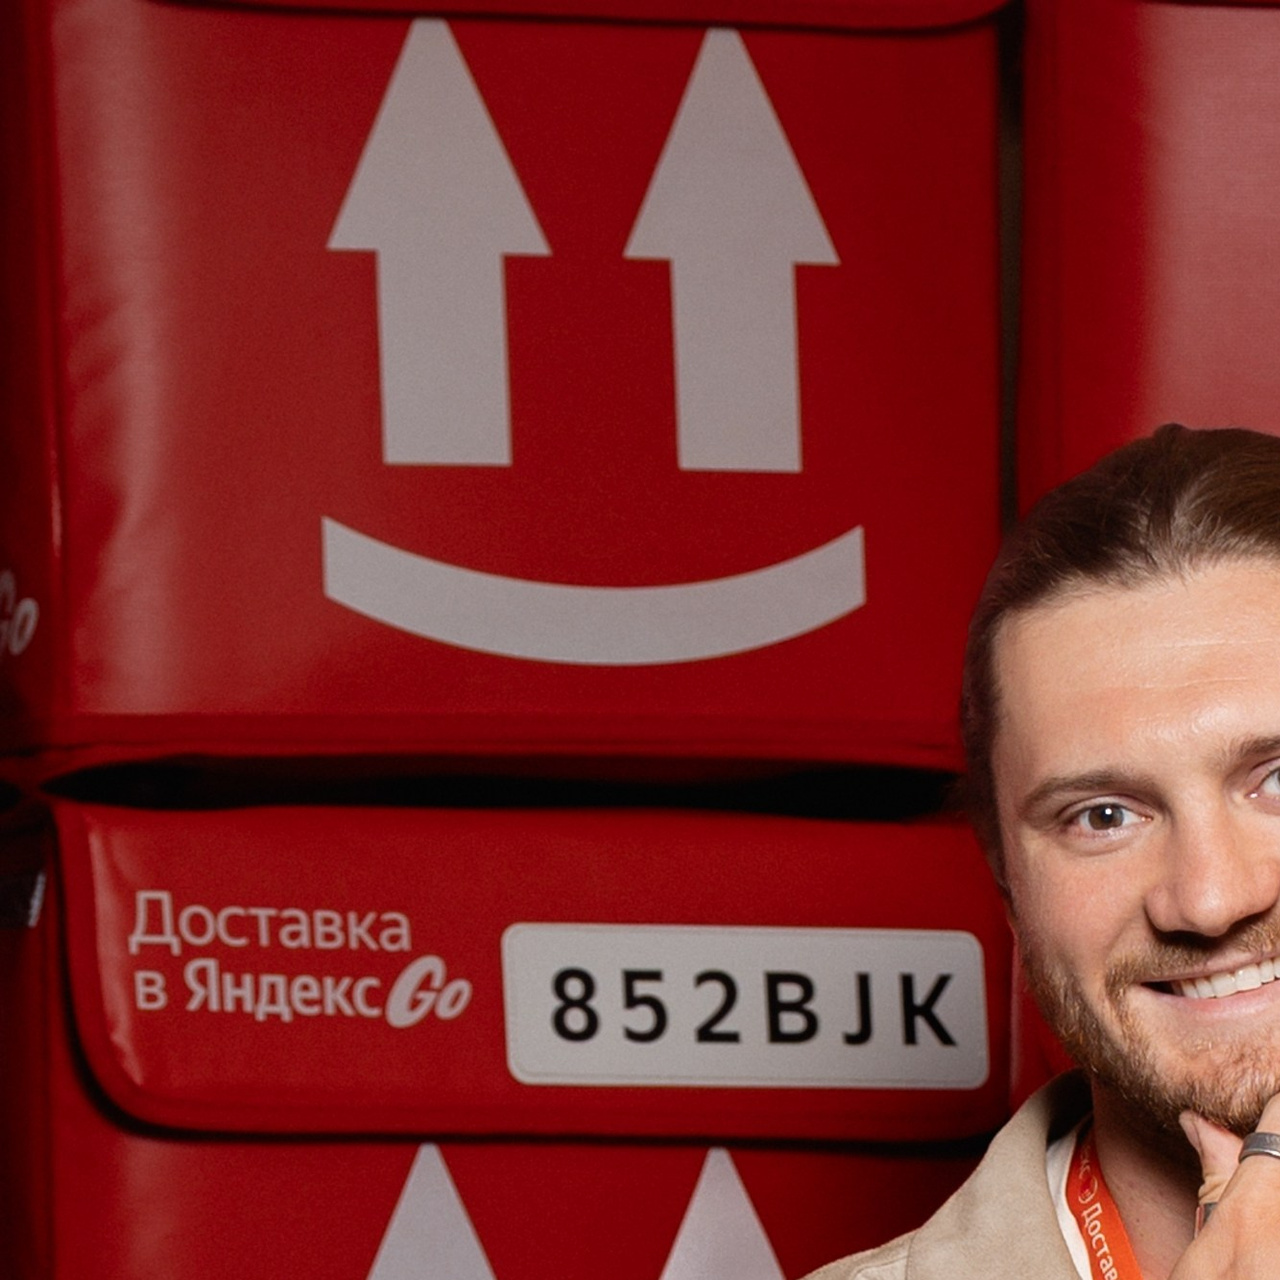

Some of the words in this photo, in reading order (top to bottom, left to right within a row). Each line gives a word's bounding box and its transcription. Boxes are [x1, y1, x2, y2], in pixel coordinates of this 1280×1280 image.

[127, 889, 413, 957] Доставка
[133, 969, 168, 1012] в
[183, 956, 384, 1023] Яндекс
[384, 954, 473, 1029] Go
[551, 967, 957, 1046] 852BJK
